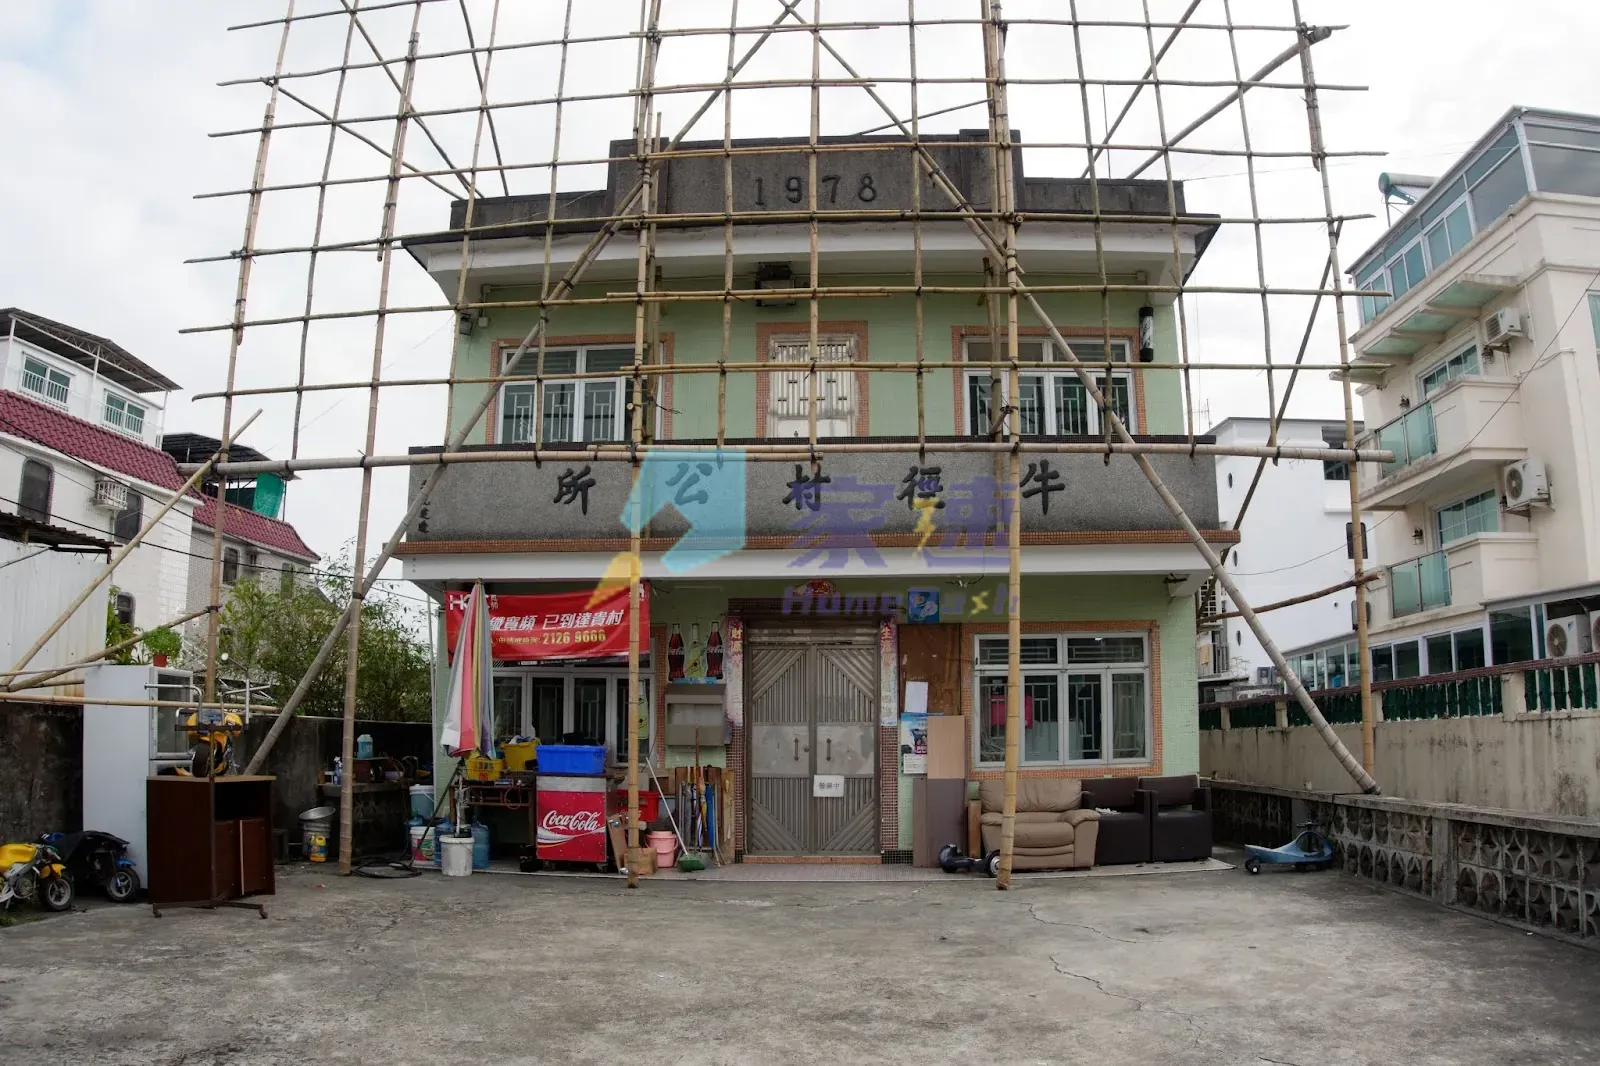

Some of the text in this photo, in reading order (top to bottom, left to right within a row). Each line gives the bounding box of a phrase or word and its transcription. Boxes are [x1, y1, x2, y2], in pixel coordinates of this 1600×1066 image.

[755, 174, 877, 205] 1978
[543, 609, 624, 630] 已到達貴村
[543, 632, 570, 645] 2126
[574, 629, 606, 643] 9666
